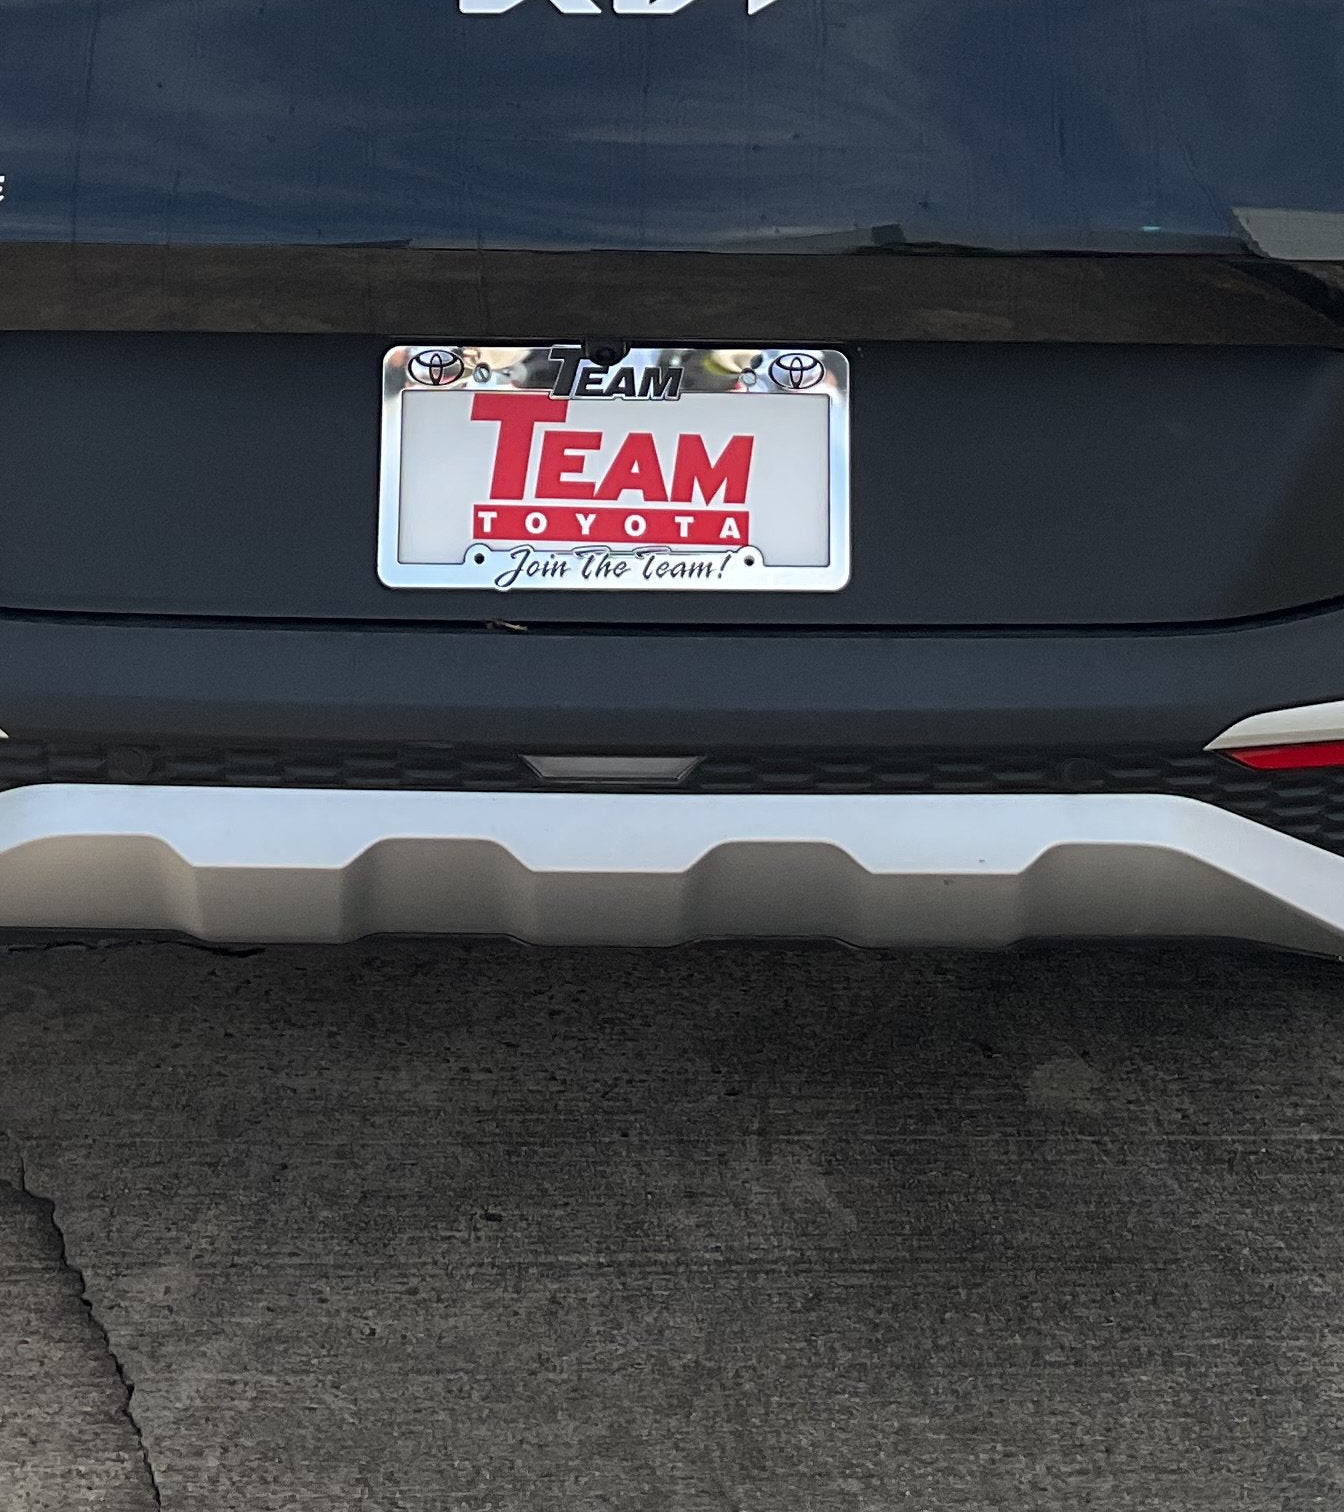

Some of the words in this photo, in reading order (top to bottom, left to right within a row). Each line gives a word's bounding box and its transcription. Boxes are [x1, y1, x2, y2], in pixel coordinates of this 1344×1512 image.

[549, 345, 683, 398] TEAM
[471, 392, 755, 506] TEAM
[477, 510, 742, 540] TOYOTA
[494, 545, 571, 588] Join
[573, 546, 632, 580] The
[633, 546, 733, 580] Team!
